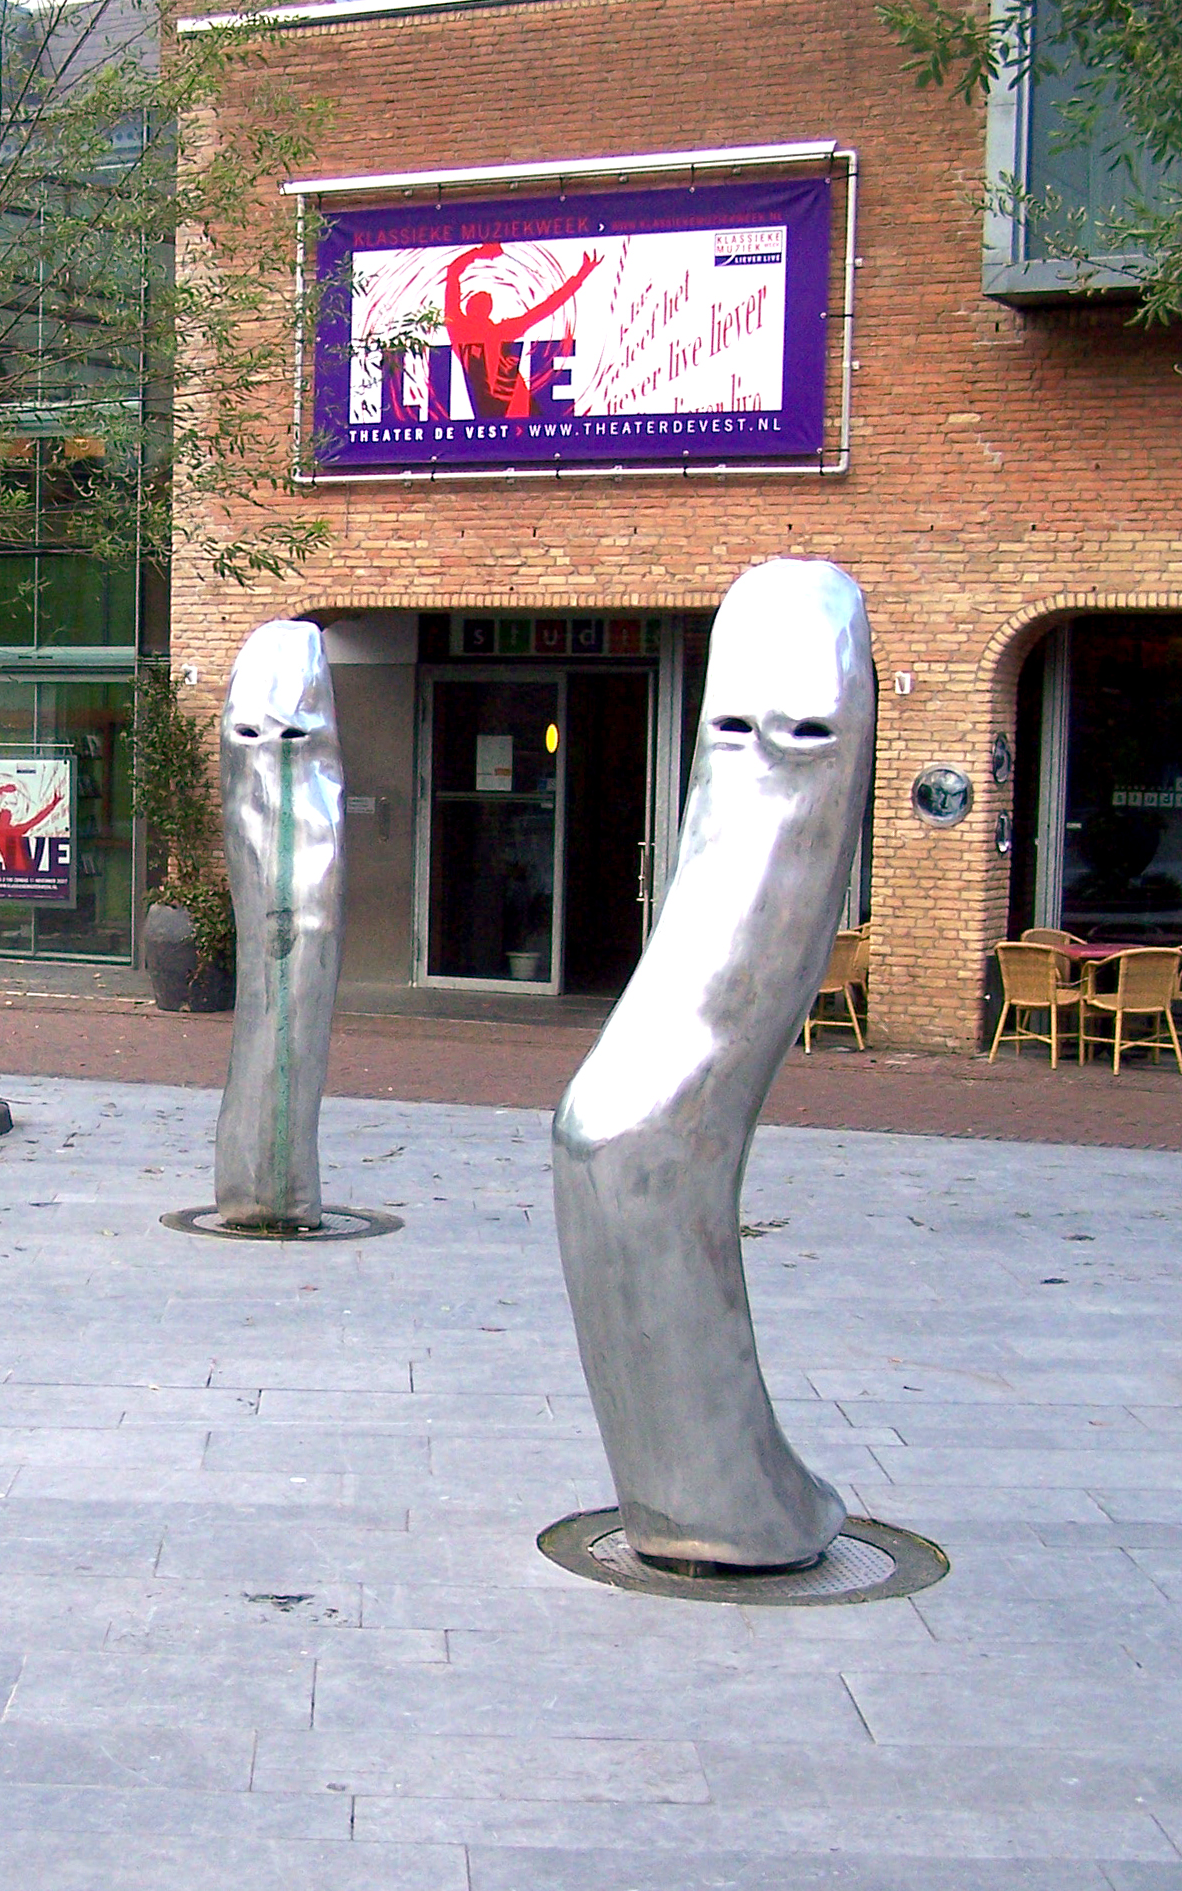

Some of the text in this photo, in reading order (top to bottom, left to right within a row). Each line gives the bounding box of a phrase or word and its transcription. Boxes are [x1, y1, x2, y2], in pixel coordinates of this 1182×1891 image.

[353, 223, 454, 248] KLASSIEKE
[460, 216, 590, 241] MUZIEKWEEK
[716, 232, 780, 244] KLASSIEKE
[709, 284, 768, 358] liever
[349, 417, 782, 443] THEATER DE VEST WWW.THEATERDEVEST.NL
